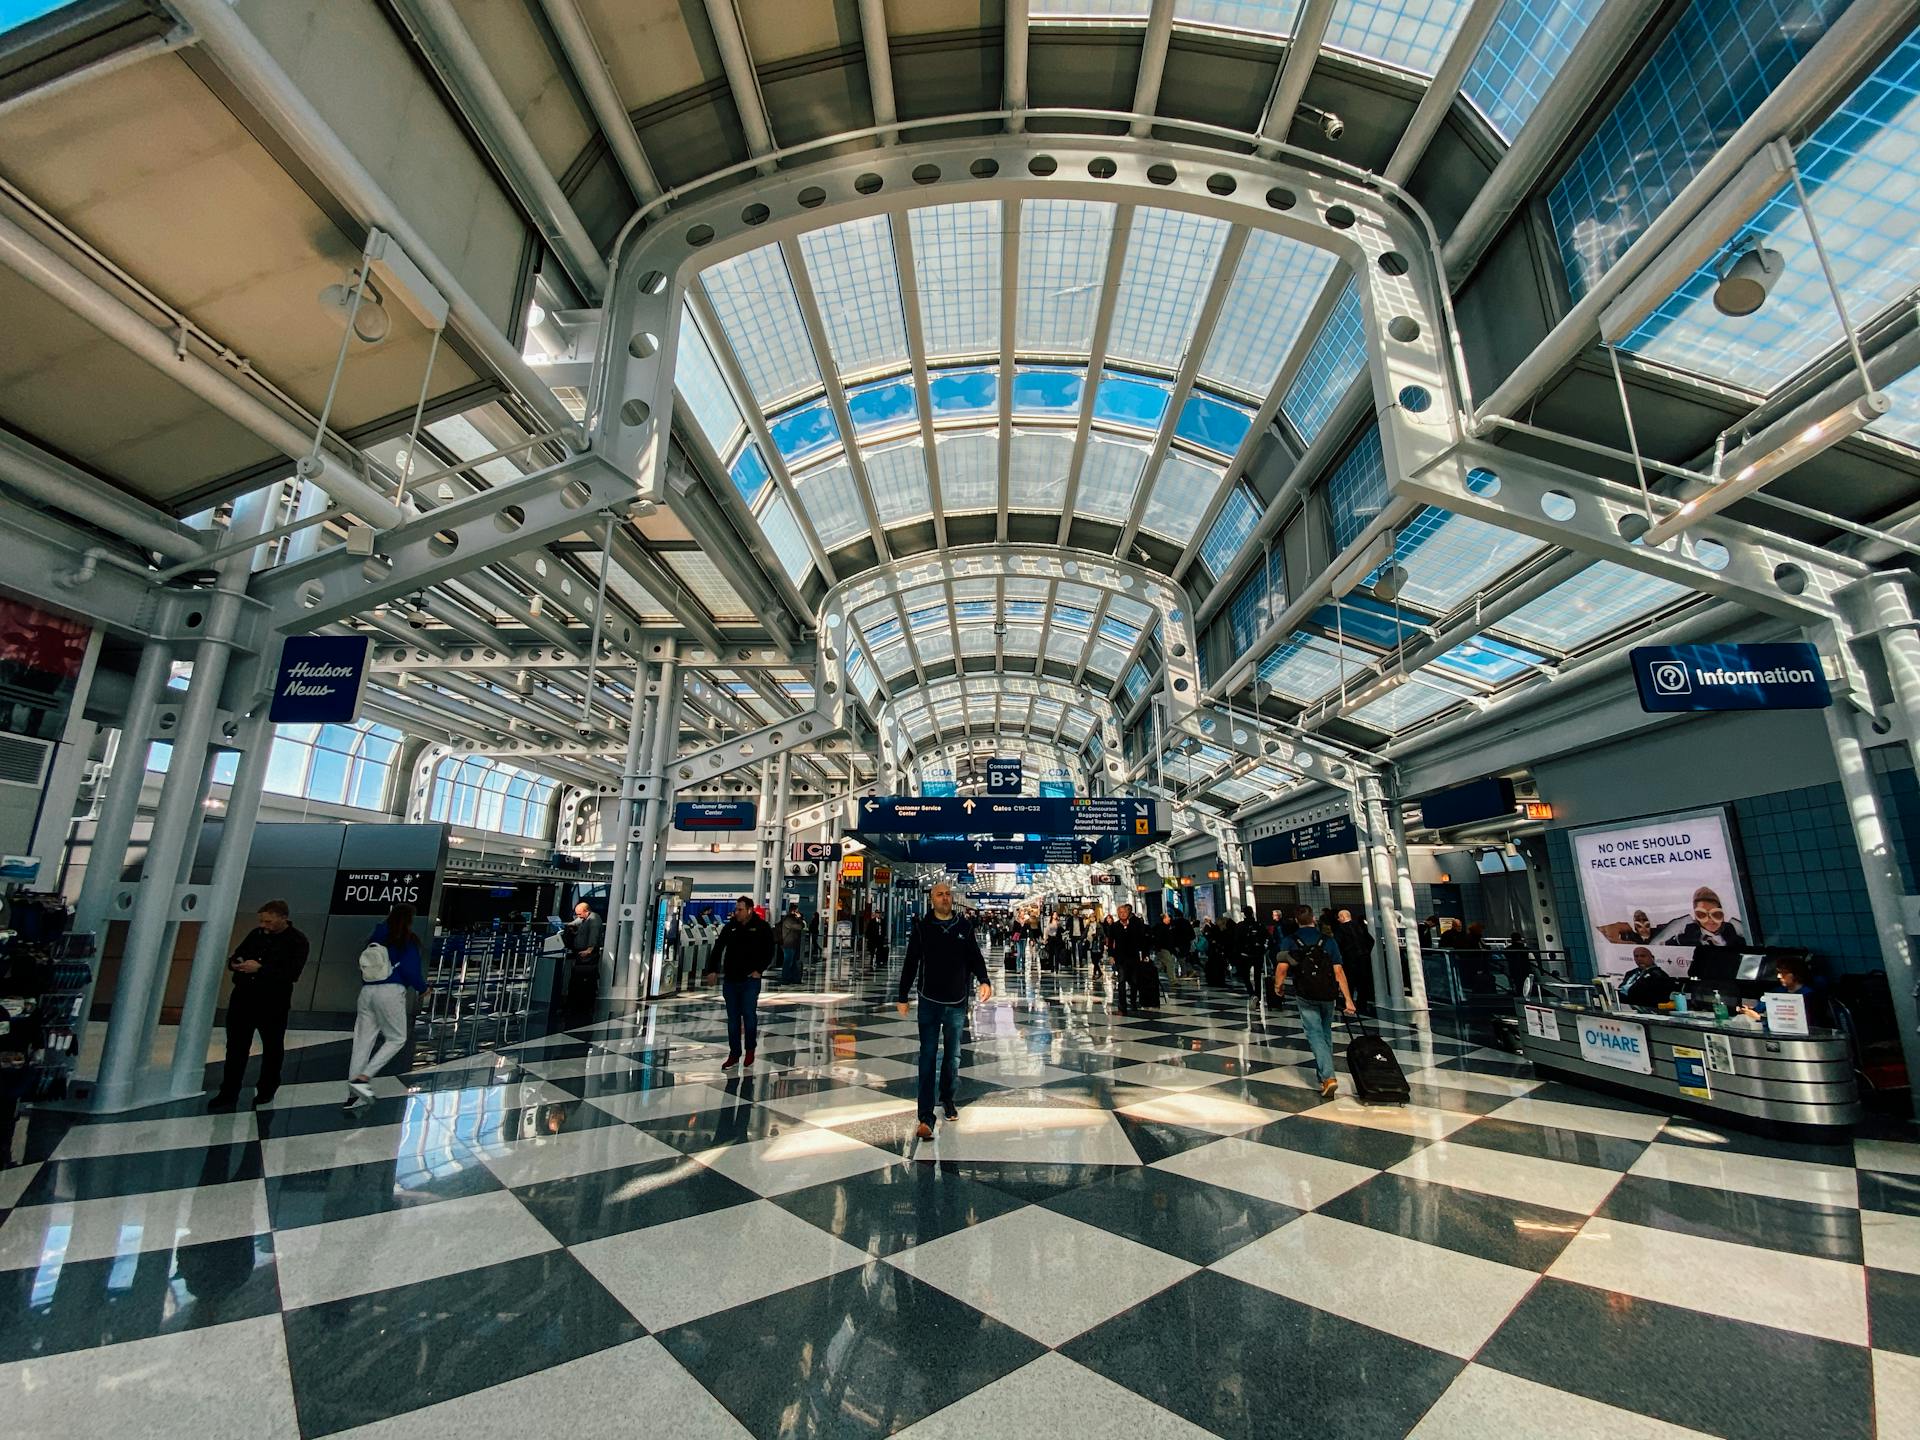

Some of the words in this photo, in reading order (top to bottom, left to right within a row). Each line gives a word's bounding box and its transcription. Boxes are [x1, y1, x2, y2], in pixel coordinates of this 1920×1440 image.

[287, 661, 353, 678] Hudson
[1695, 666, 1815, 686] Information
[282, 680, 336, 697] News
[990, 771, 1004, 787] B
[992, 804, 1012, 812] Gates
[1528, 804, 1549, 816] EXIT
[1598, 843, 1614, 854] NO
[1616, 840, 1639, 851] ONE
[1642, 834, 1691, 849] SHOULD
[1591, 857, 1617, 869] FACE
[1619, 853, 1666, 867] CANCER
[1669, 848, 1712, 863] ALONE
[348, 873, 380, 881] UNITED
[344, 885, 419, 903] POLARIS
[1585, 1029, 1640, 1054] O'HARE
